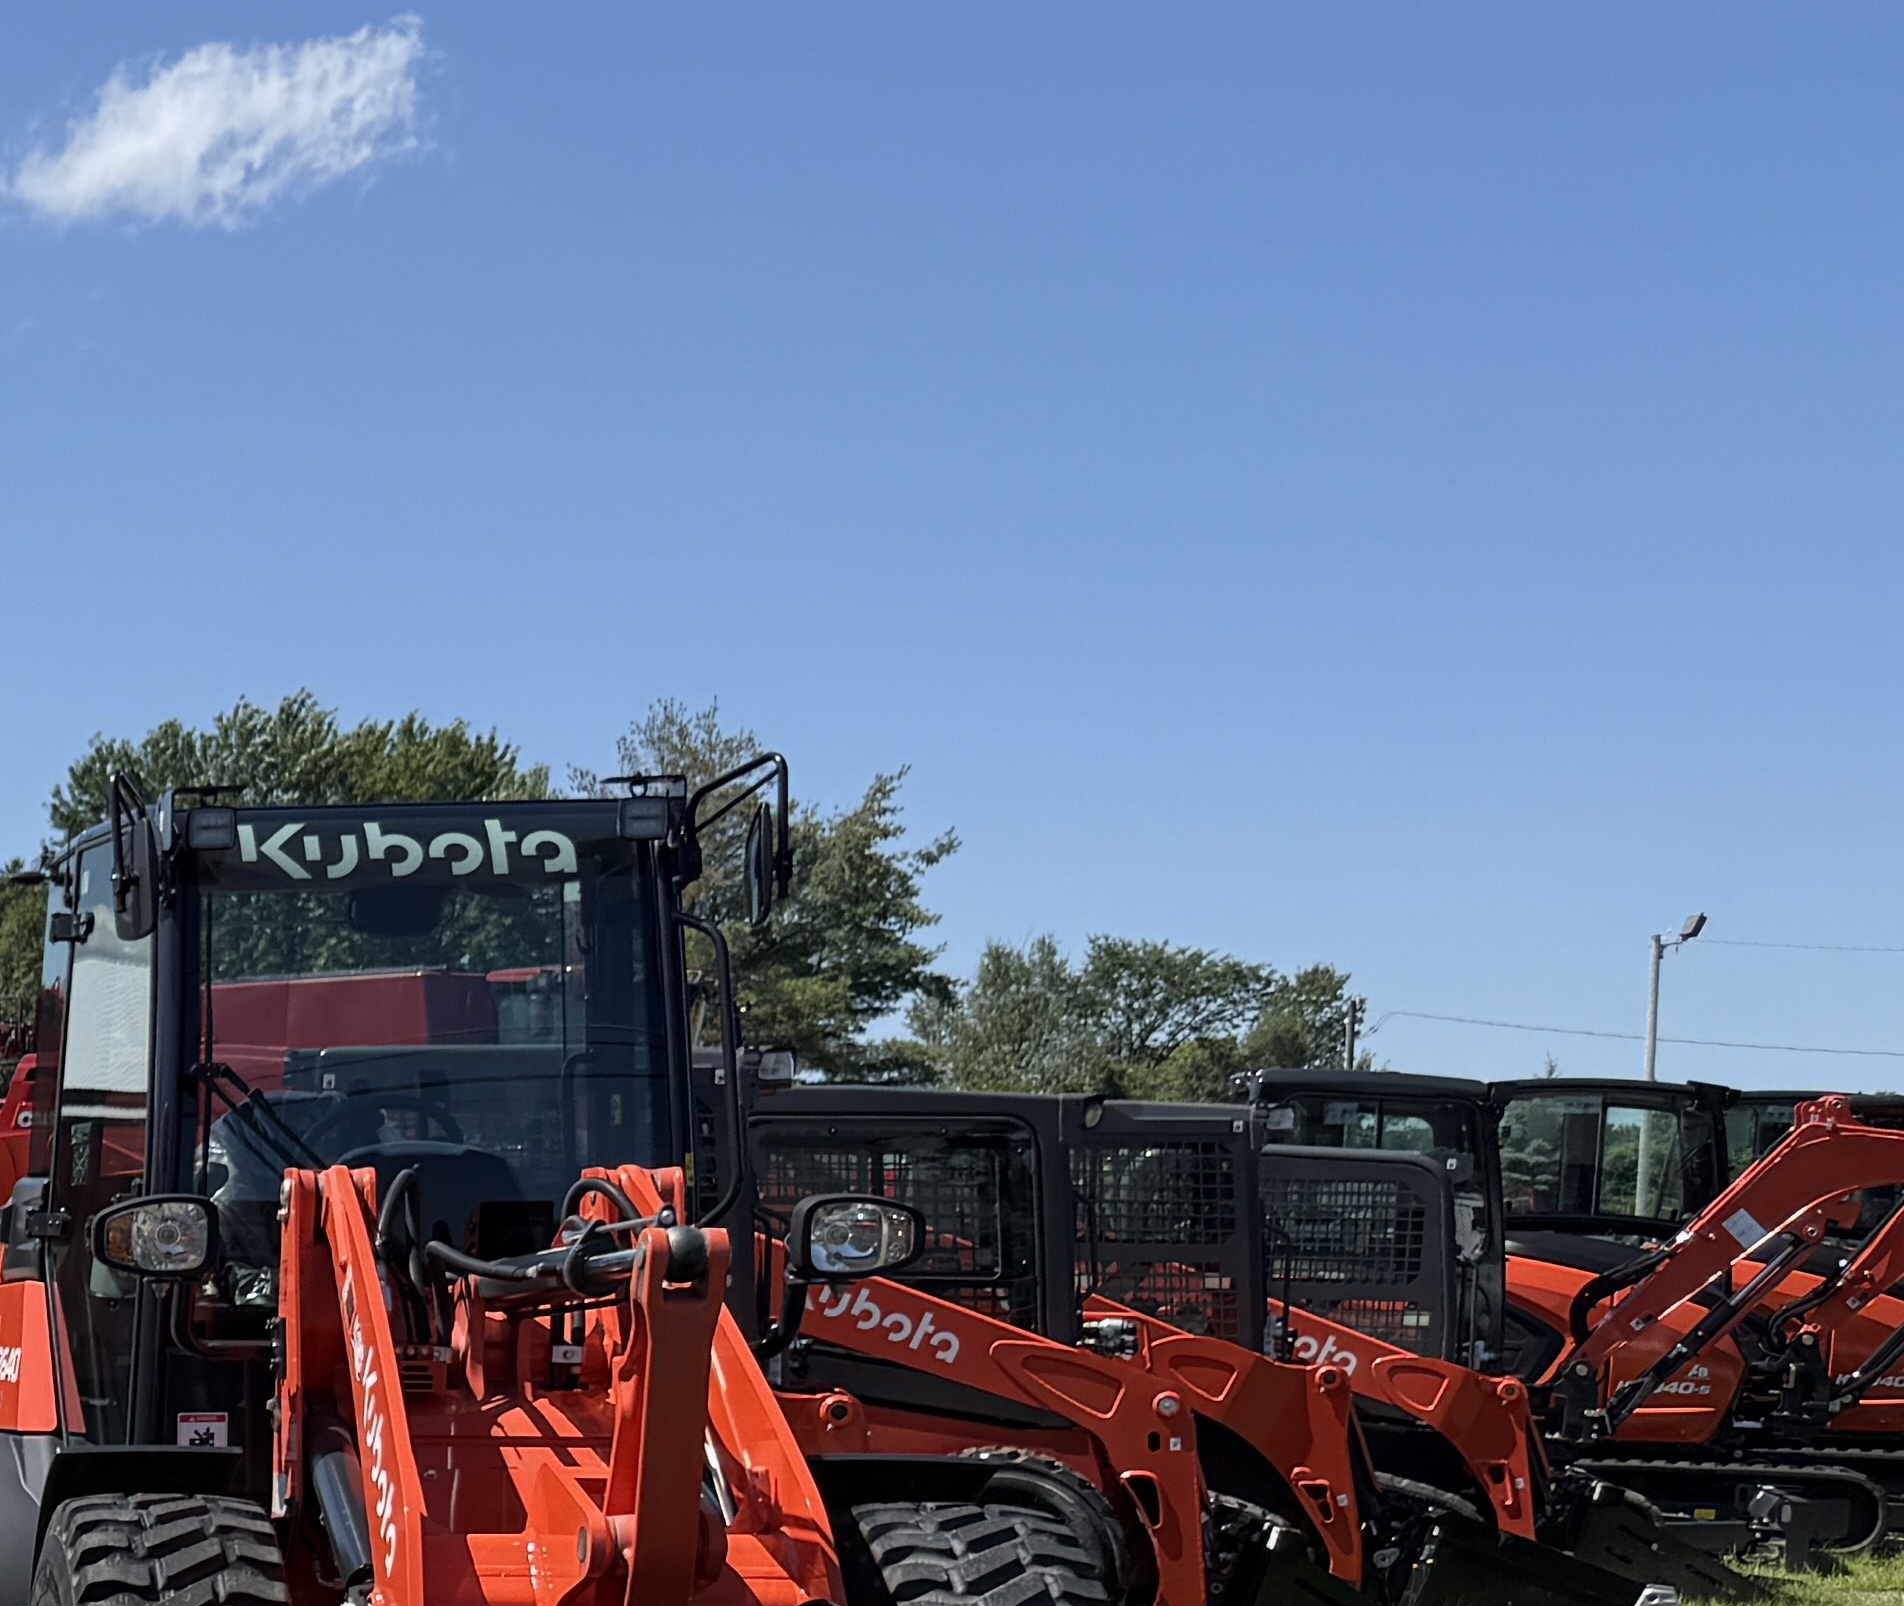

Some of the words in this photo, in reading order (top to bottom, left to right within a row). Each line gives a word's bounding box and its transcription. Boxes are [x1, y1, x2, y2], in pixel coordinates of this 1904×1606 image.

[236, 818, 579, 880] Kubota
[804, 1283, 961, 1365] ubota
[362, 1344, 397, 1579] Kubota
